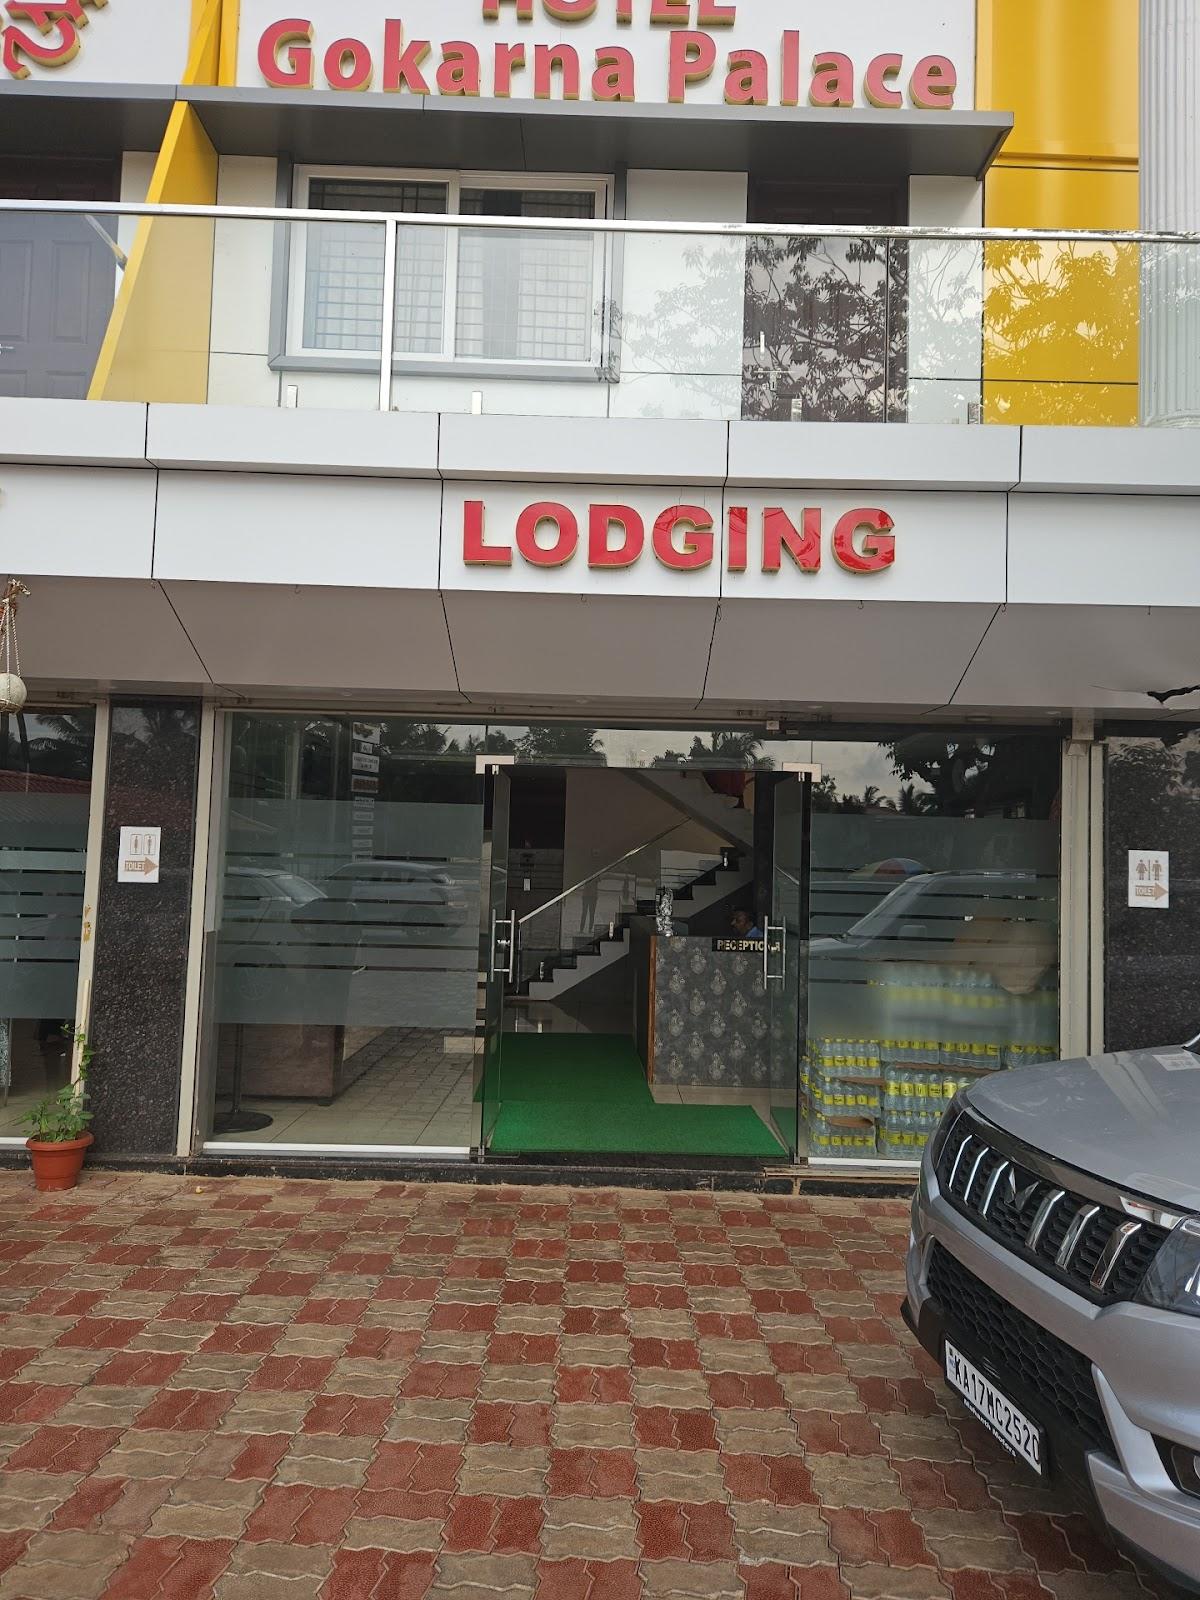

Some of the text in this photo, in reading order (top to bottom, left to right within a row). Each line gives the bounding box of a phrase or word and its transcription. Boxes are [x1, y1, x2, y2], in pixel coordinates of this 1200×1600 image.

[257, 18, 957, 109] Gokarna Palace
[463, 500, 896, 574] LODGING
